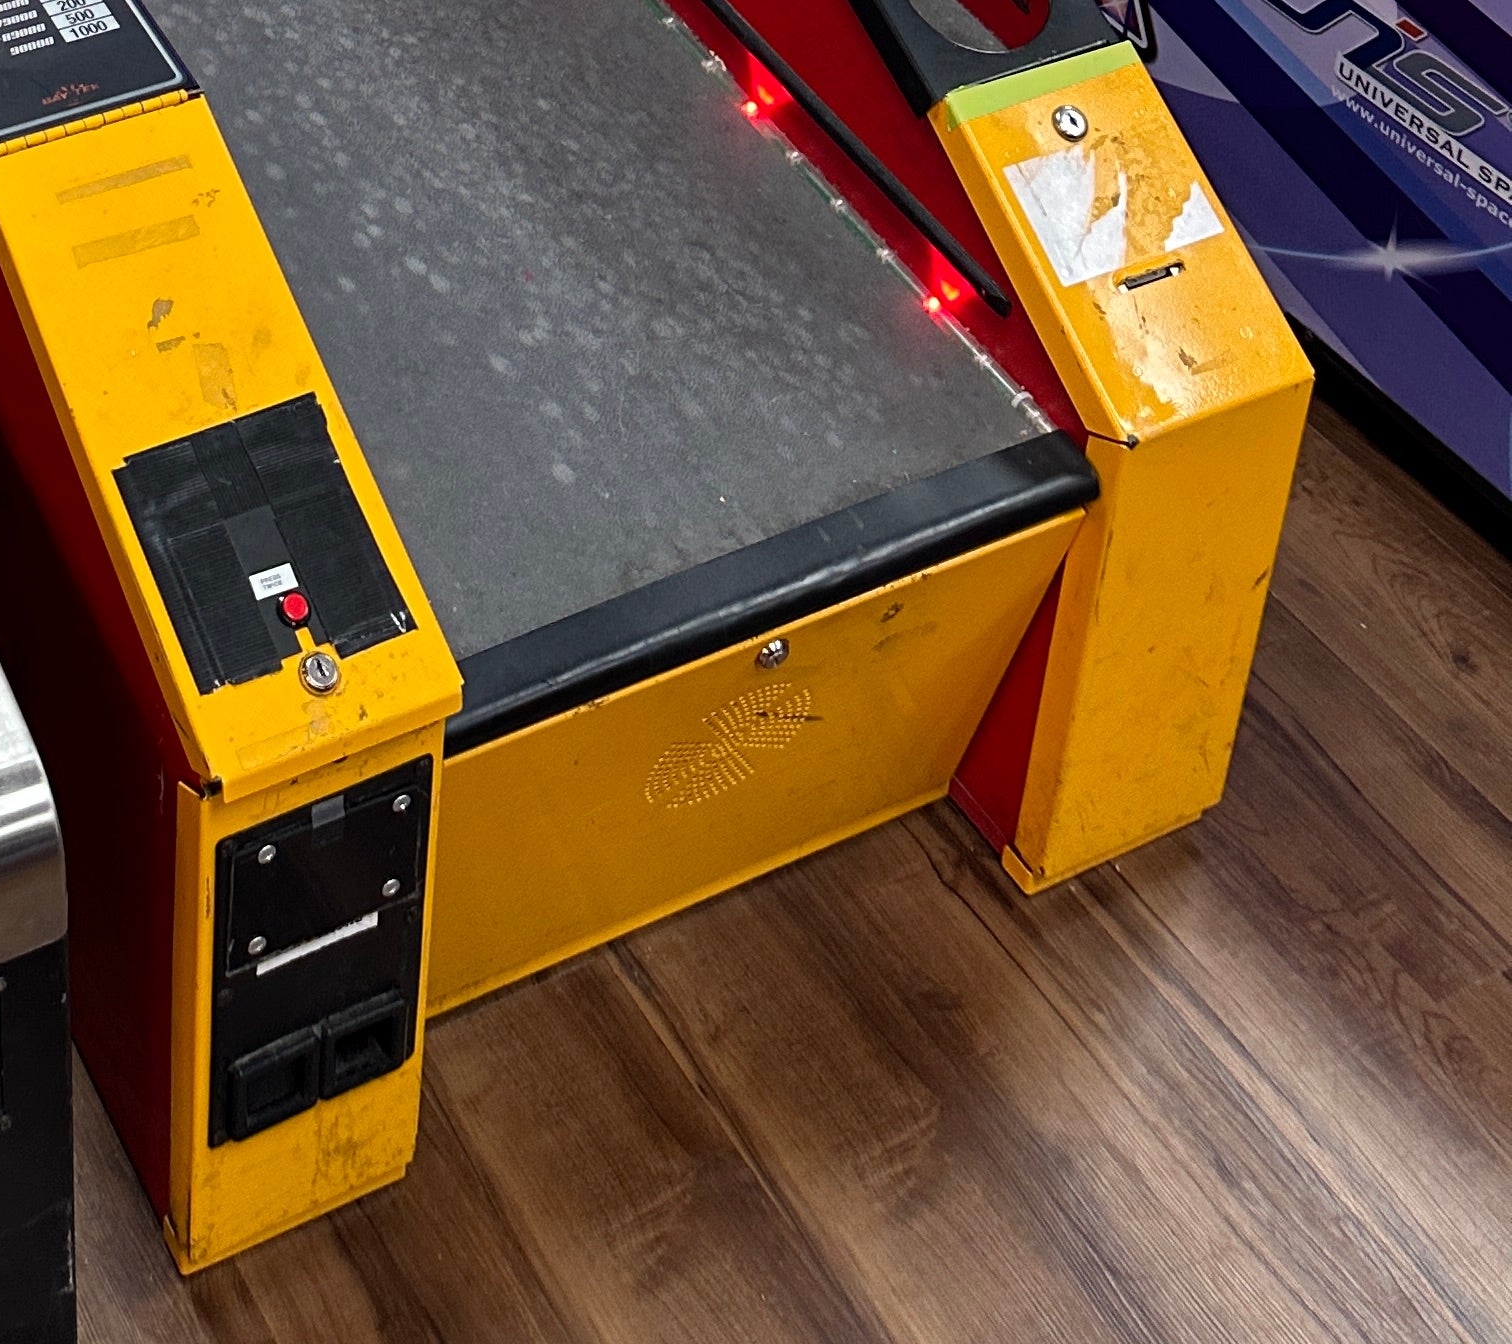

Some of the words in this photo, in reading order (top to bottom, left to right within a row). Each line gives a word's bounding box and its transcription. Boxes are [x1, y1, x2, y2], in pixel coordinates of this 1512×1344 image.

[65, 8, 95, 25] 500
[69, 19, 109, 39] 1000
[1337, 61, 1470, 171] UNIVERSAL
[1478, 164, 1512, 202] SP
